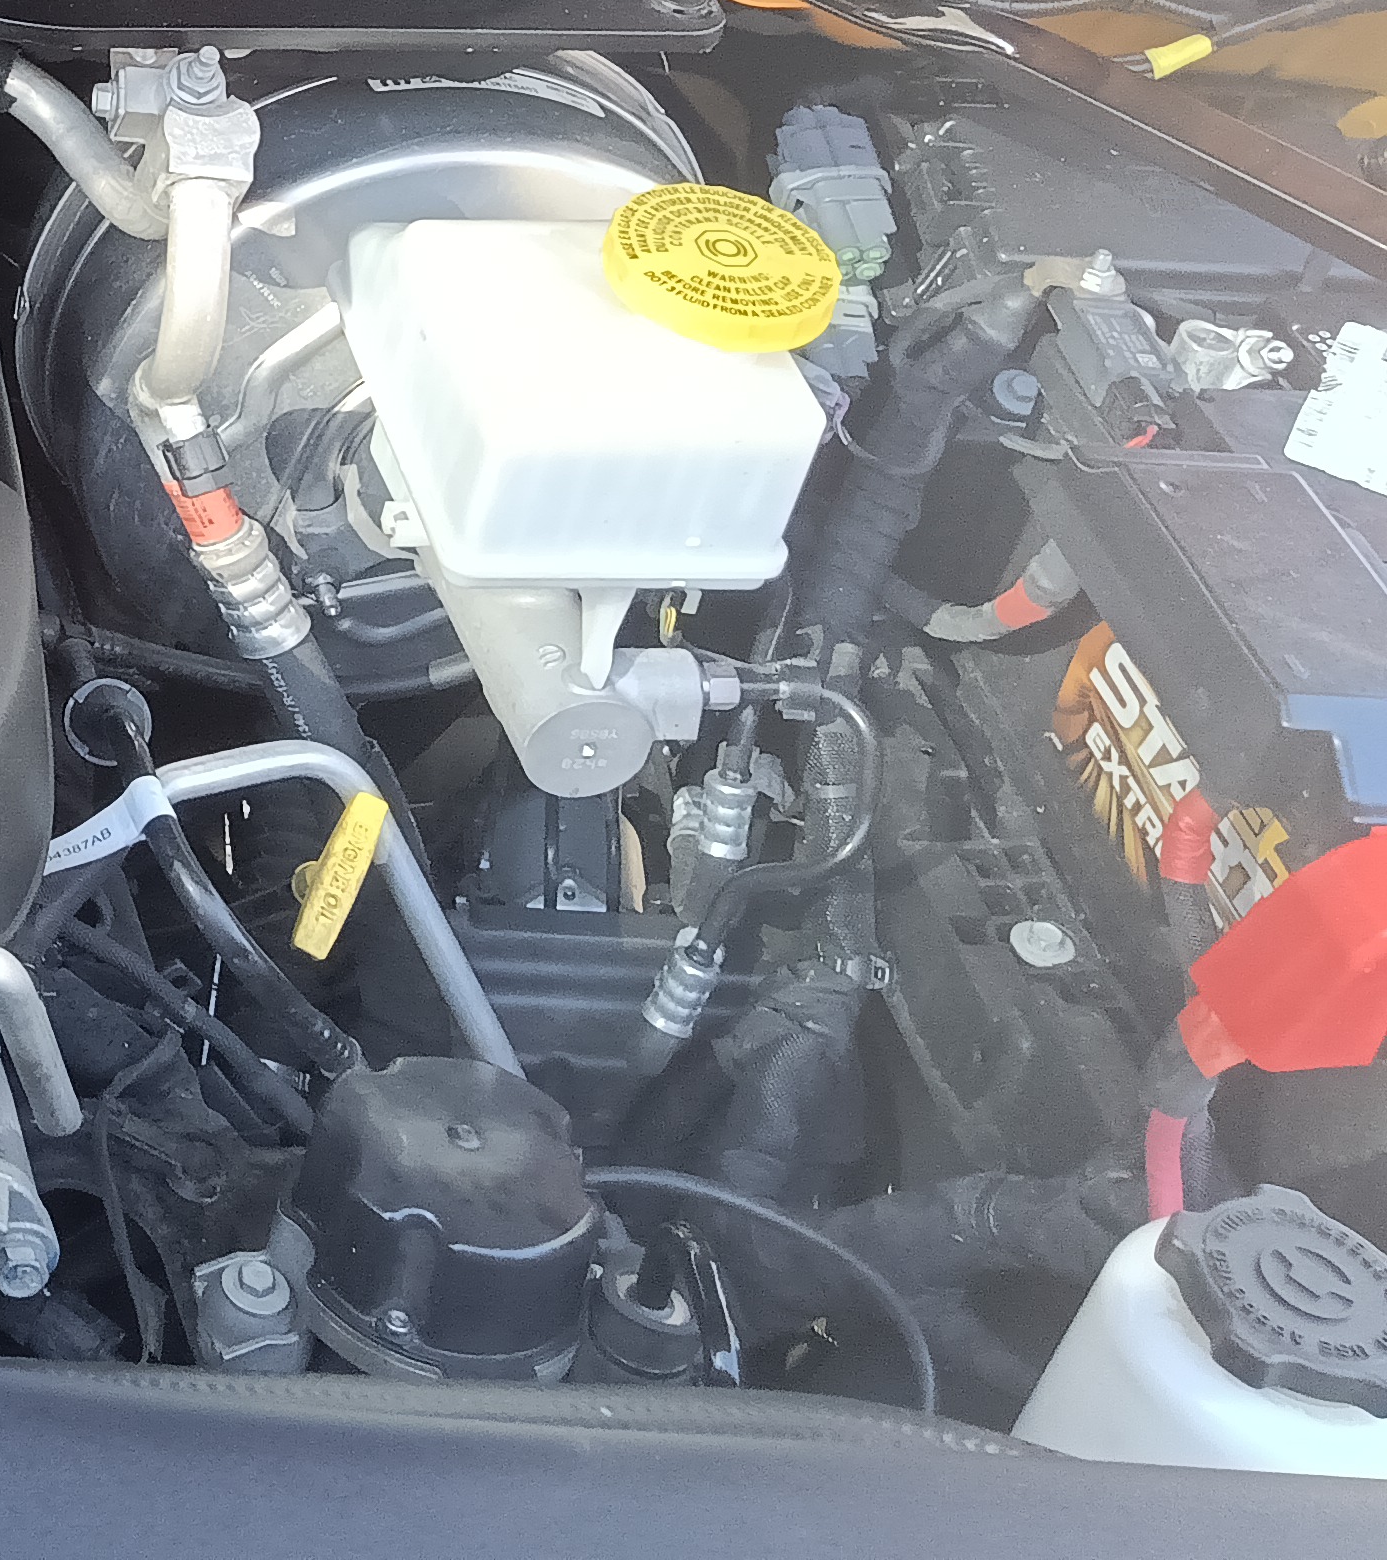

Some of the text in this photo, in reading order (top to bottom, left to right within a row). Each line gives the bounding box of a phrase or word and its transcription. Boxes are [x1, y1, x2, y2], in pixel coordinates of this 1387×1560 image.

[668, 215, 720, 247] CONTENANT
[696, 196, 752, 213] UTILISER
[753, 210, 813, 257] UNIQUEMENT
[699, 186, 759, 207] BOUCHON
[760, 202, 776, 215] DE
[778, 213, 831, 262] REMPLISSAGE
[703, 206, 779, 236] PROVENANT
[643, 270, 669, 287] DOT
[675, 289, 711, 308] FLUID
[712, 303, 749, 317] FROM
[751, 309, 761, 318] A
[761, 303, 804, 319] SEALED
[660, 269, 707, 298] BEFORE
[780, 288, 804, 303] USE
[797, 271, 817, 292] ONLY
[689, 274, 793, 297] CLEAN FILLER CAP
[315, 822, 370, 924] ENGINE OIL
